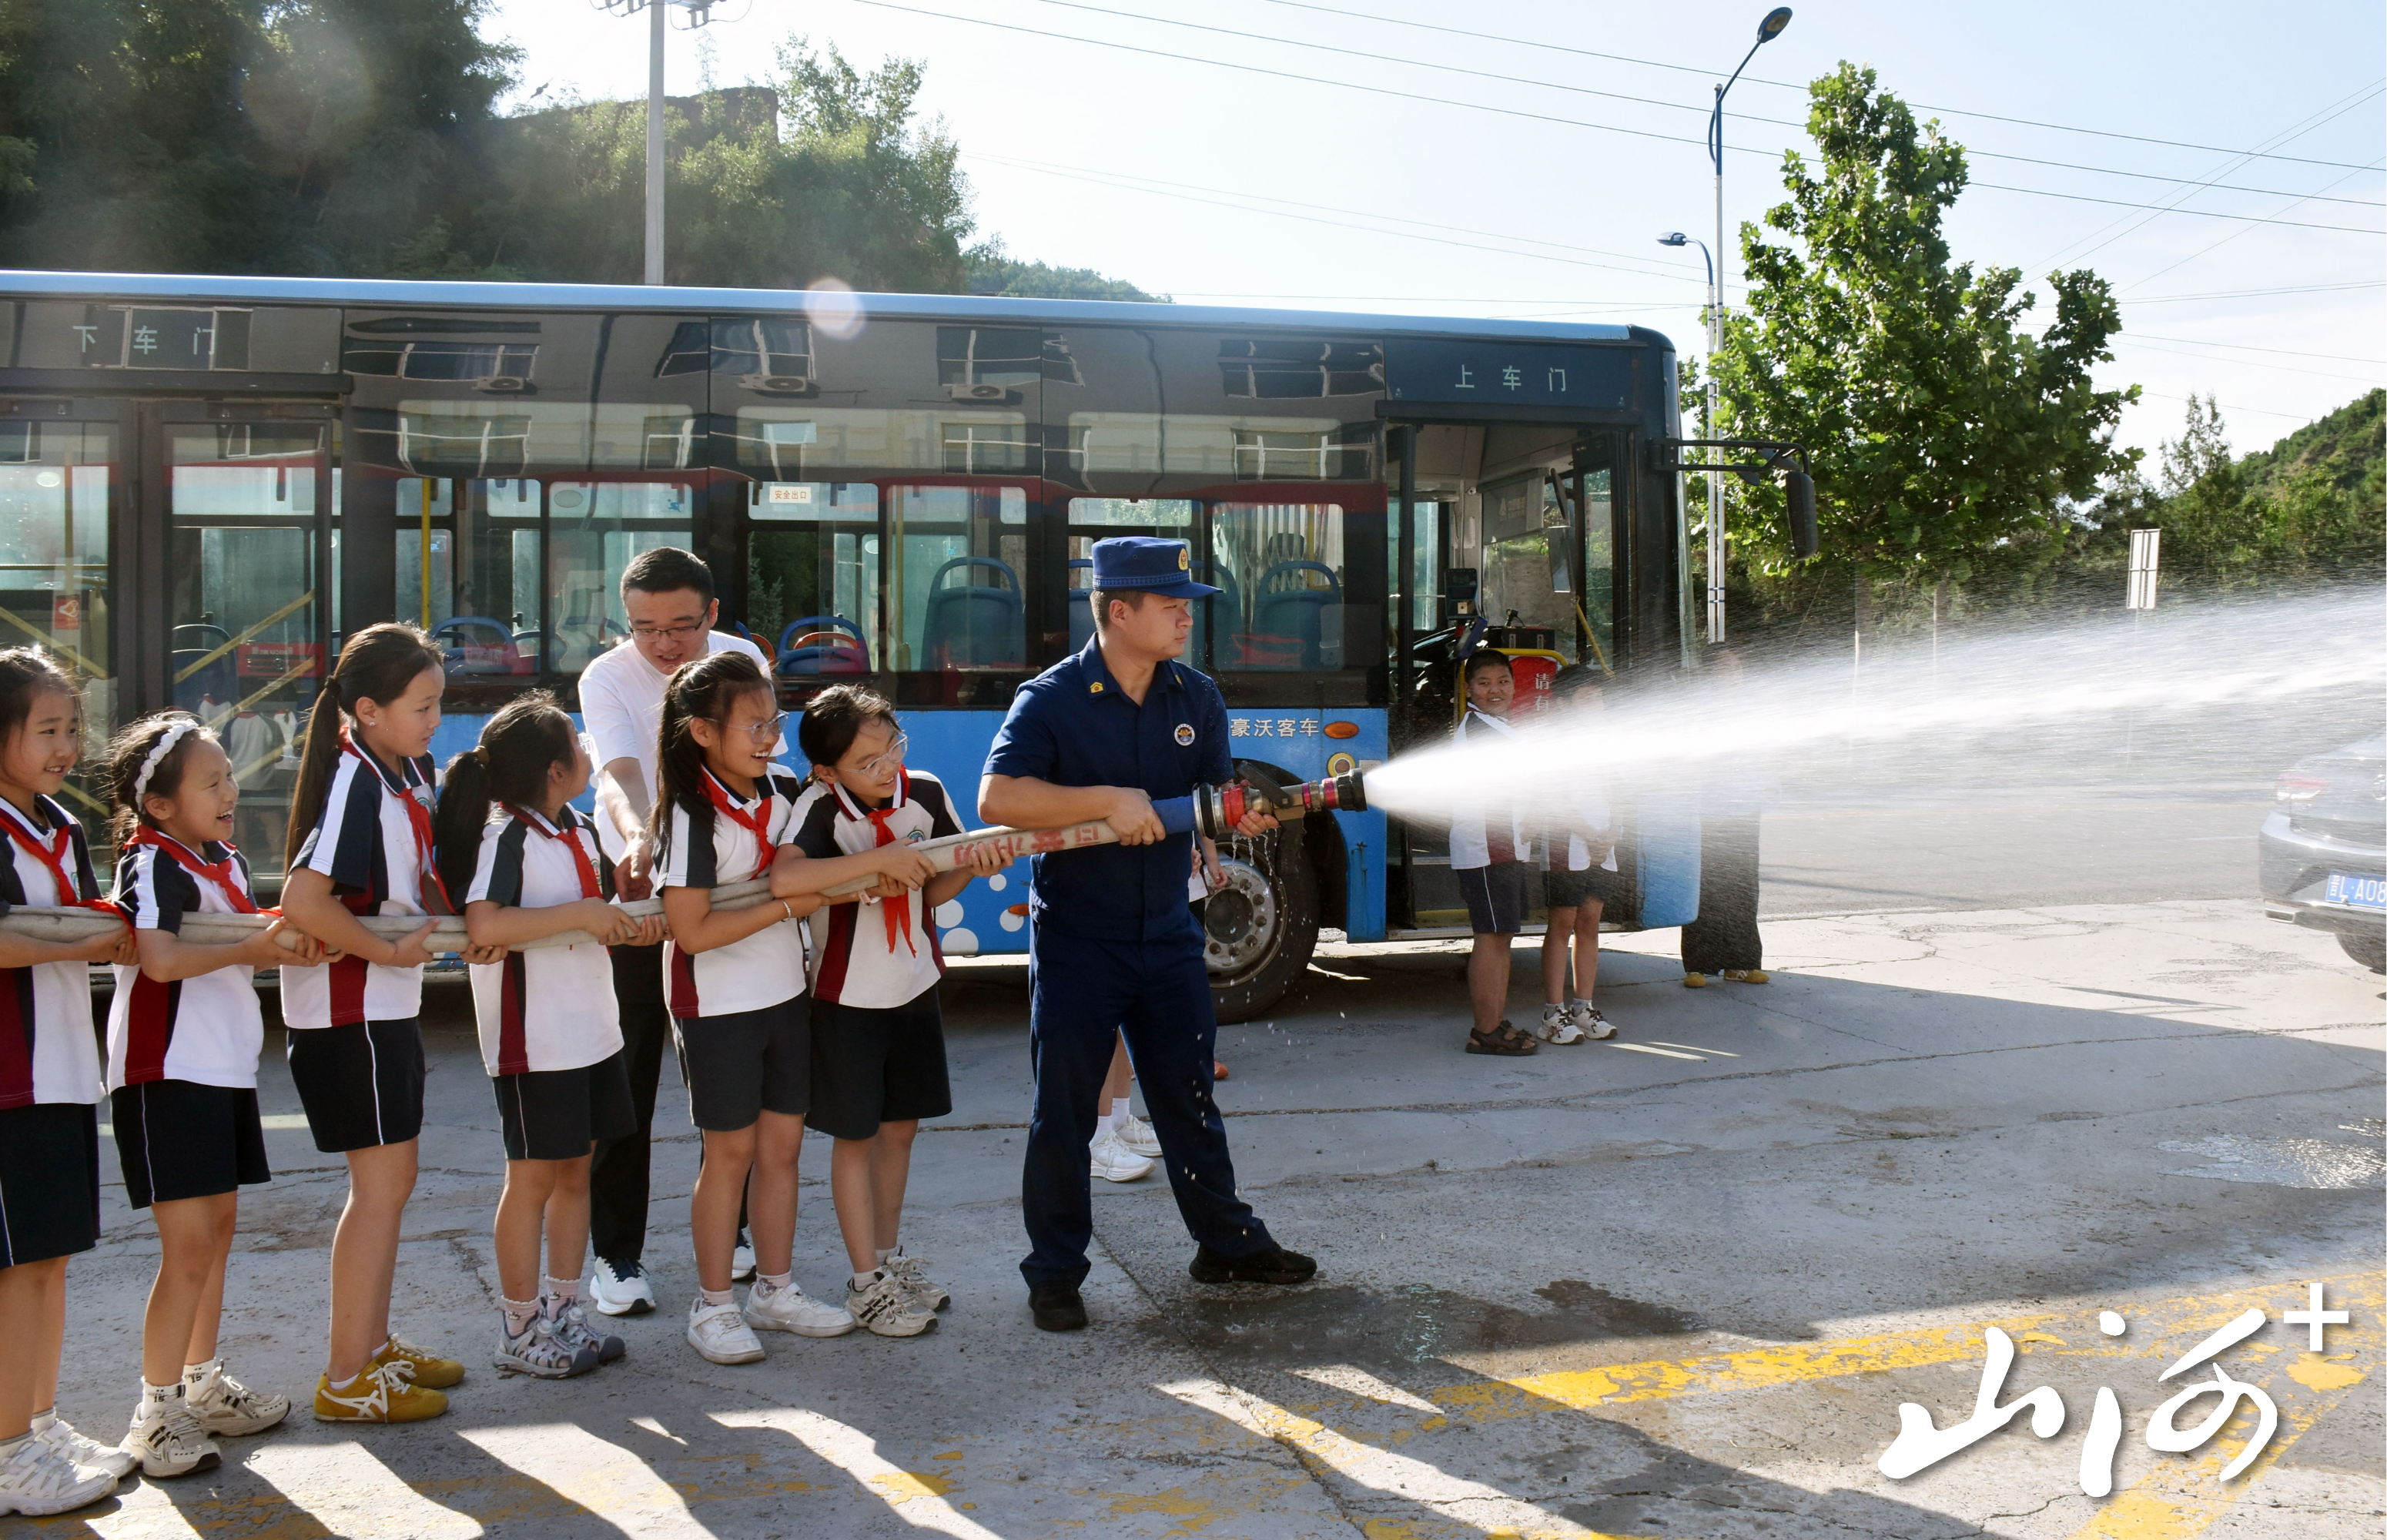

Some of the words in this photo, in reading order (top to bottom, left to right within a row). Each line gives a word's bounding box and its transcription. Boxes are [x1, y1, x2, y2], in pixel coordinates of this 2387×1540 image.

[72, 325, 216, 355] 下车门
[1455, 364, 1566, 392] 上车门
[775, 490, 807, 500] 安全出口
[1230, 718, 1319, 738] 豪沃客车
